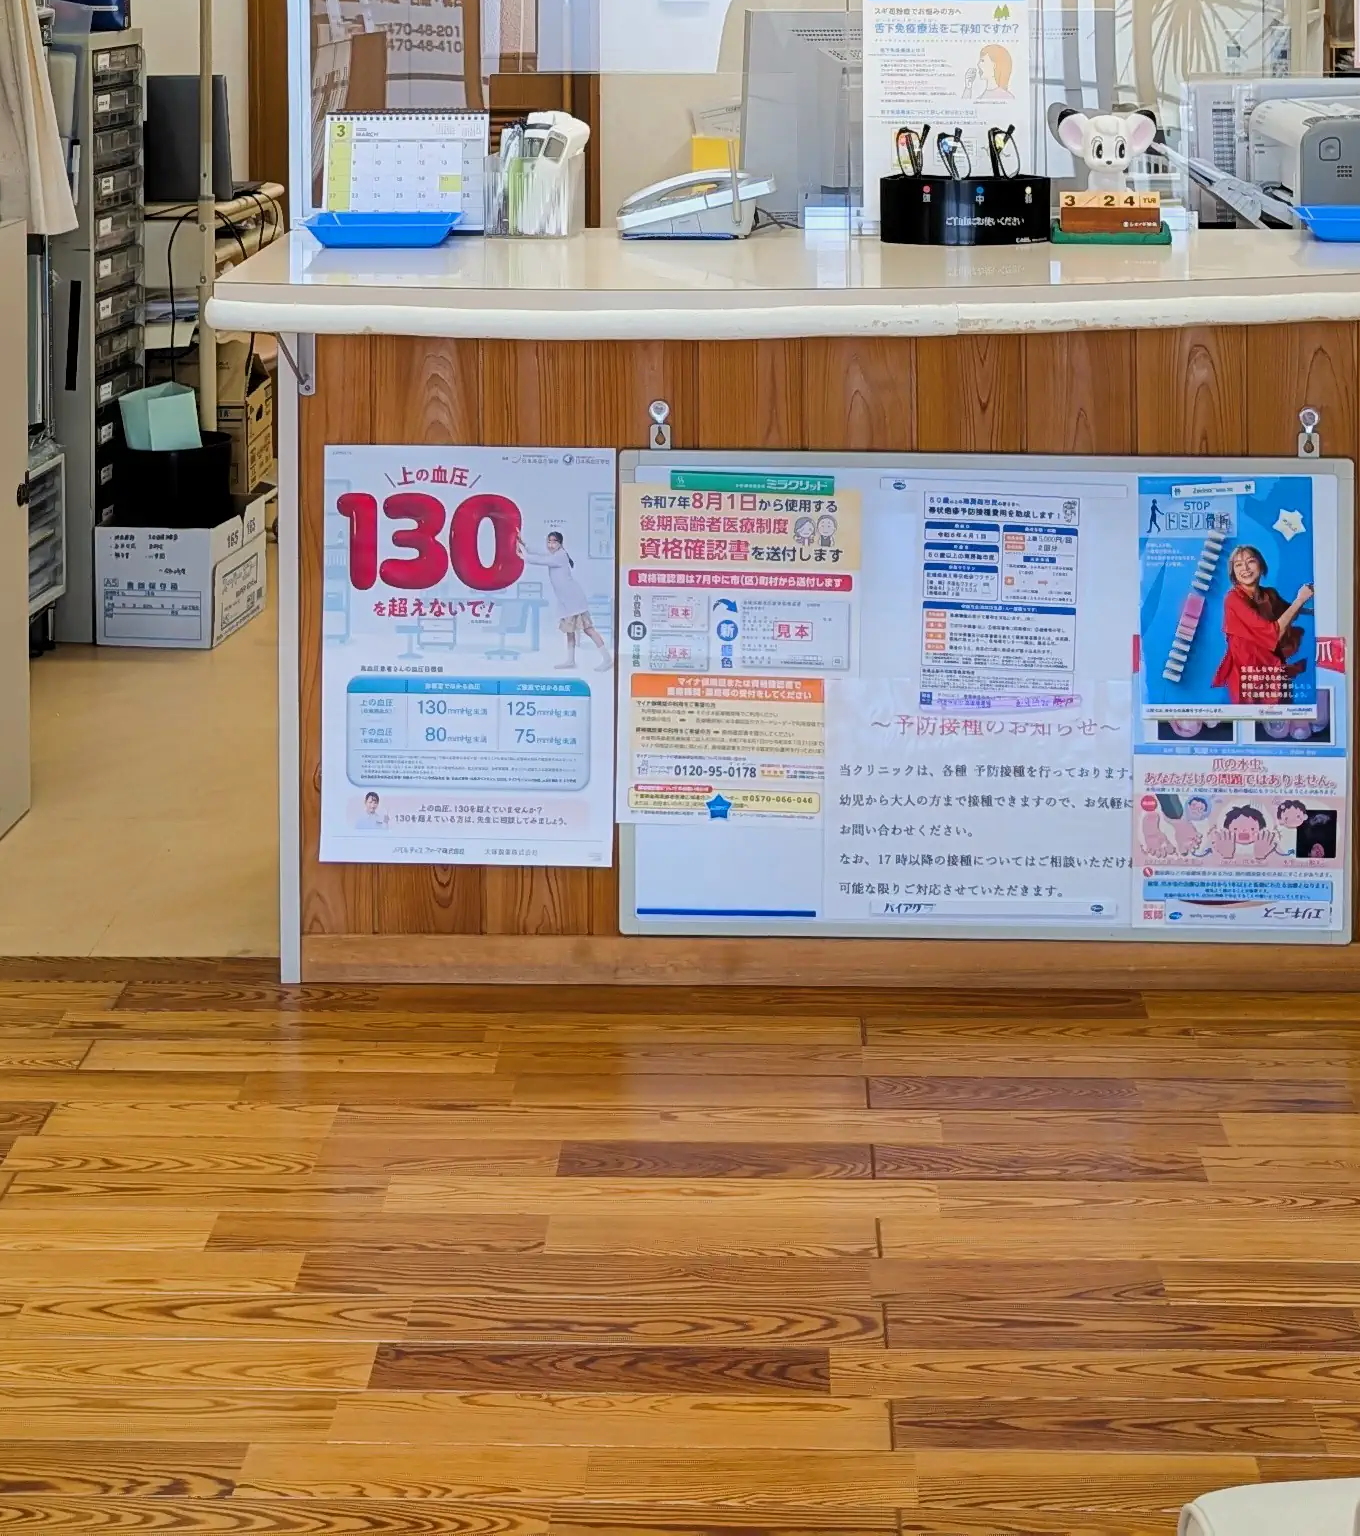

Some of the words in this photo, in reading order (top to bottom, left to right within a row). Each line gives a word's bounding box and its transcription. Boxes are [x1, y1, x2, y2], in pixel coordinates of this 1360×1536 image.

[337, 125, 346, 137] 3
[976, 195, 984, 204] 中
[398, 465, 470, 487] 上の血圧
[766, 479, 827, 491] ミラクリッド
[640, 493, 837, 513] 令和7年8月1日から使用する
[1184, 502, 1210, 511] STOP
[640, 515, 789, 534] 後期高齢者医療制度
[336, 492, 525, 591] 130
[640, 537, 843, 562] 資格確認書を送付します
[720, 624, 734, 636] 新
[776, 624, 810, 638] 見本
[675, 765, 757, 778] 0120-95-0178
[840, 824, 974, 838] お問い合わせください。
[839, 883, 1063, 897] 可能な限りご対応させていただきます。
